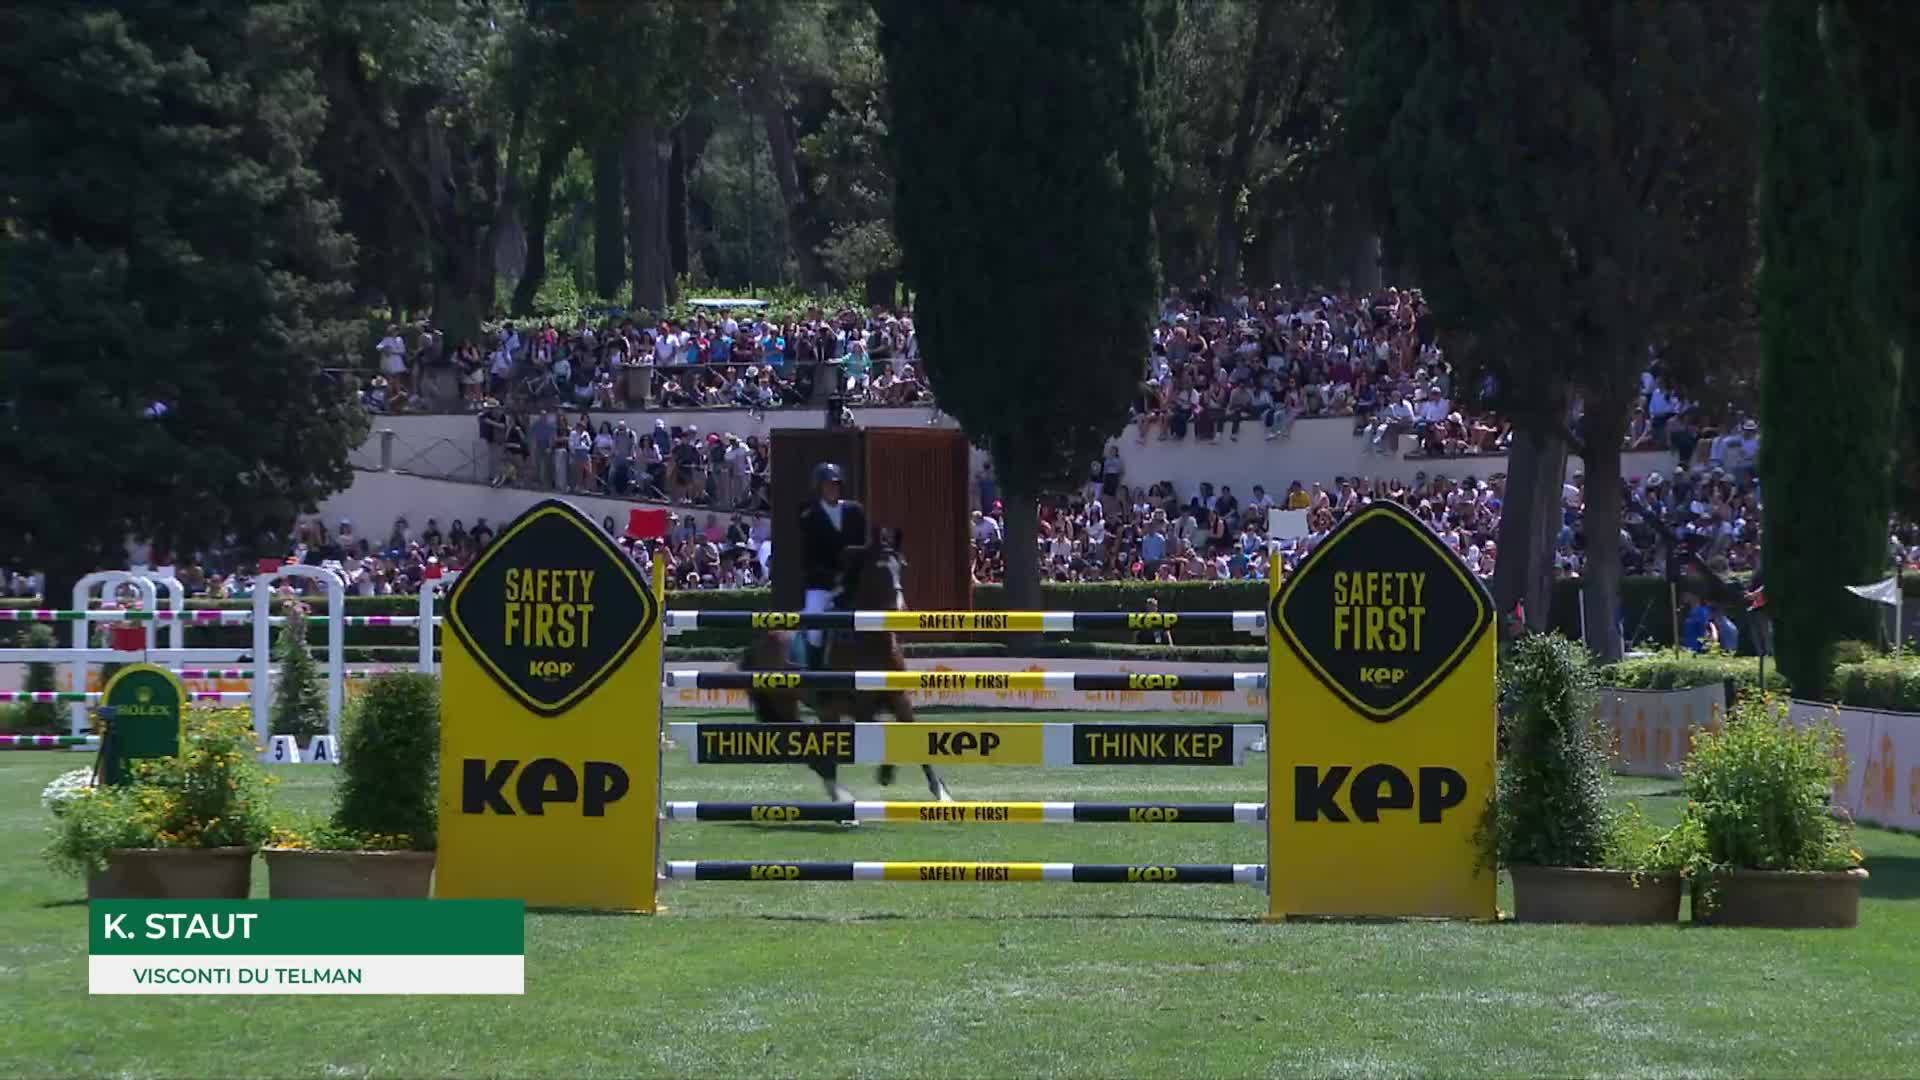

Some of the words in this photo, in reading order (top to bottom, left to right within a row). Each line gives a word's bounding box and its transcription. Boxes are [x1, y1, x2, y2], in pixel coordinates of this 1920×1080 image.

[505, 568, 595, 602] SAFETY
[1333, 571, 1426, 605] SAFETY
[505, 603, 594, 648] FIRST
[919, 614, 966, 629] SAFETY
[974, 614, 1008, 629] FIRST
[1333, 606, 1426, 652] FIRST
[920, 675, 966, 688] SAFETY
[975, 675, 1009, 688] FIRST
[117, 704, 169, 715] ROLEX
[273, 740, 284, 760] 5
[314, 740, 327, 760] A
[701, 731, 780, 756] THINK
[788, 731, 851, 756] SAFE
[1085, 733, 1166, 758] THINK
[1174, 733, 1223, 758] KEP
[920, 807, 966, 821] SAFETY
[975, 807, 1009, 821] FIRST
[920, 867, 966, 880] SAFETY
[975, 867, 1009, 880] FIRST
